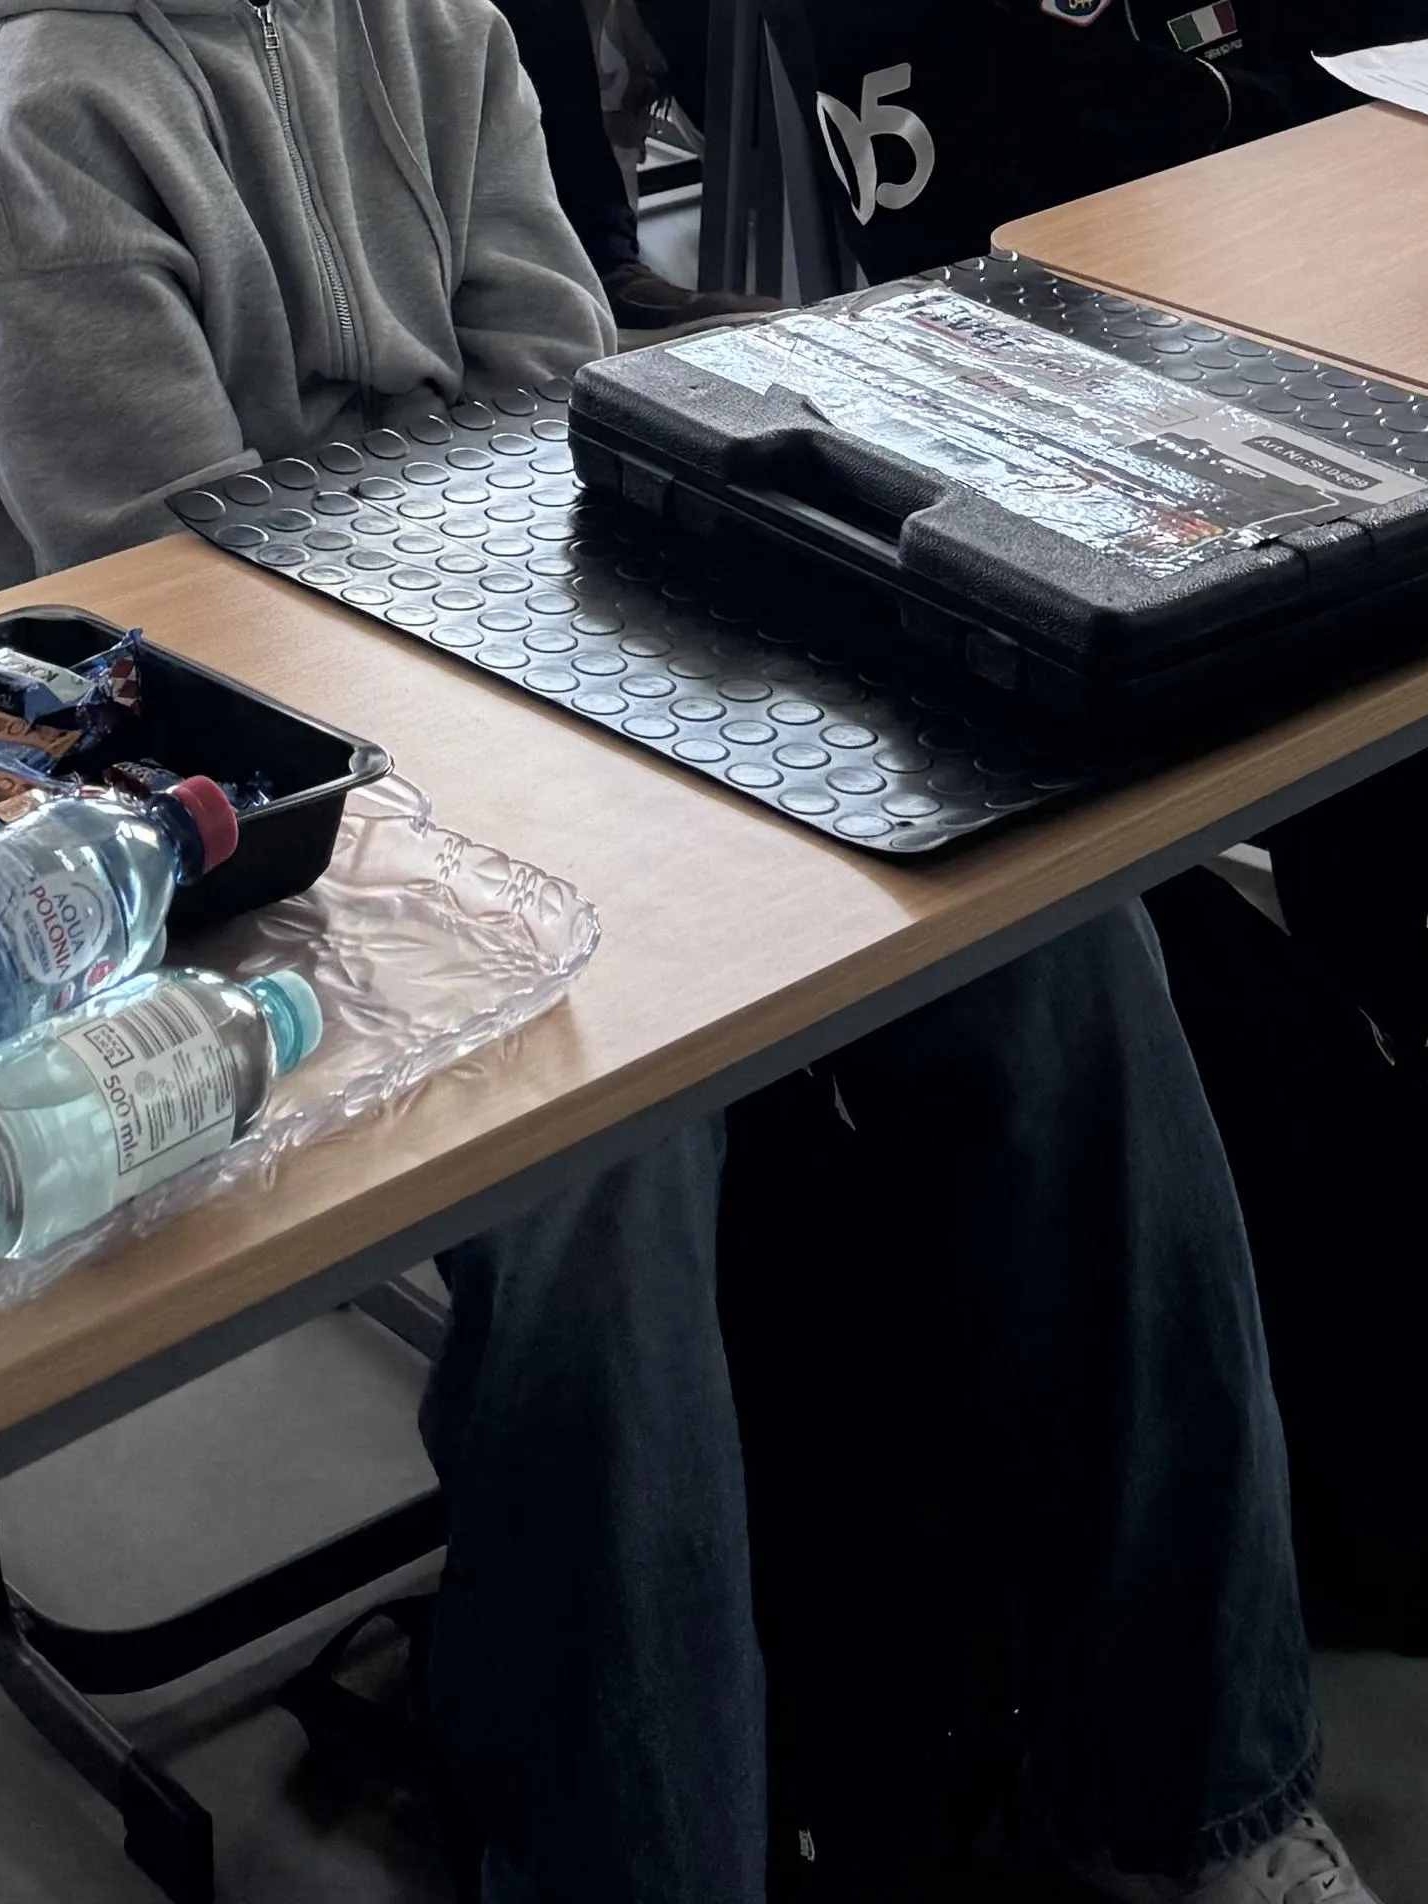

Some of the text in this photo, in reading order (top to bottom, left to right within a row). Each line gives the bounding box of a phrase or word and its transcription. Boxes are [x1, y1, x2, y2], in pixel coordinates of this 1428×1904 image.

[29, 884, 73, 979] POLONIA
[53, 893, 87, 957] AQUA
[103, 1074, 132, 1117] 500
[119, 1123, 139, 1154] ml
